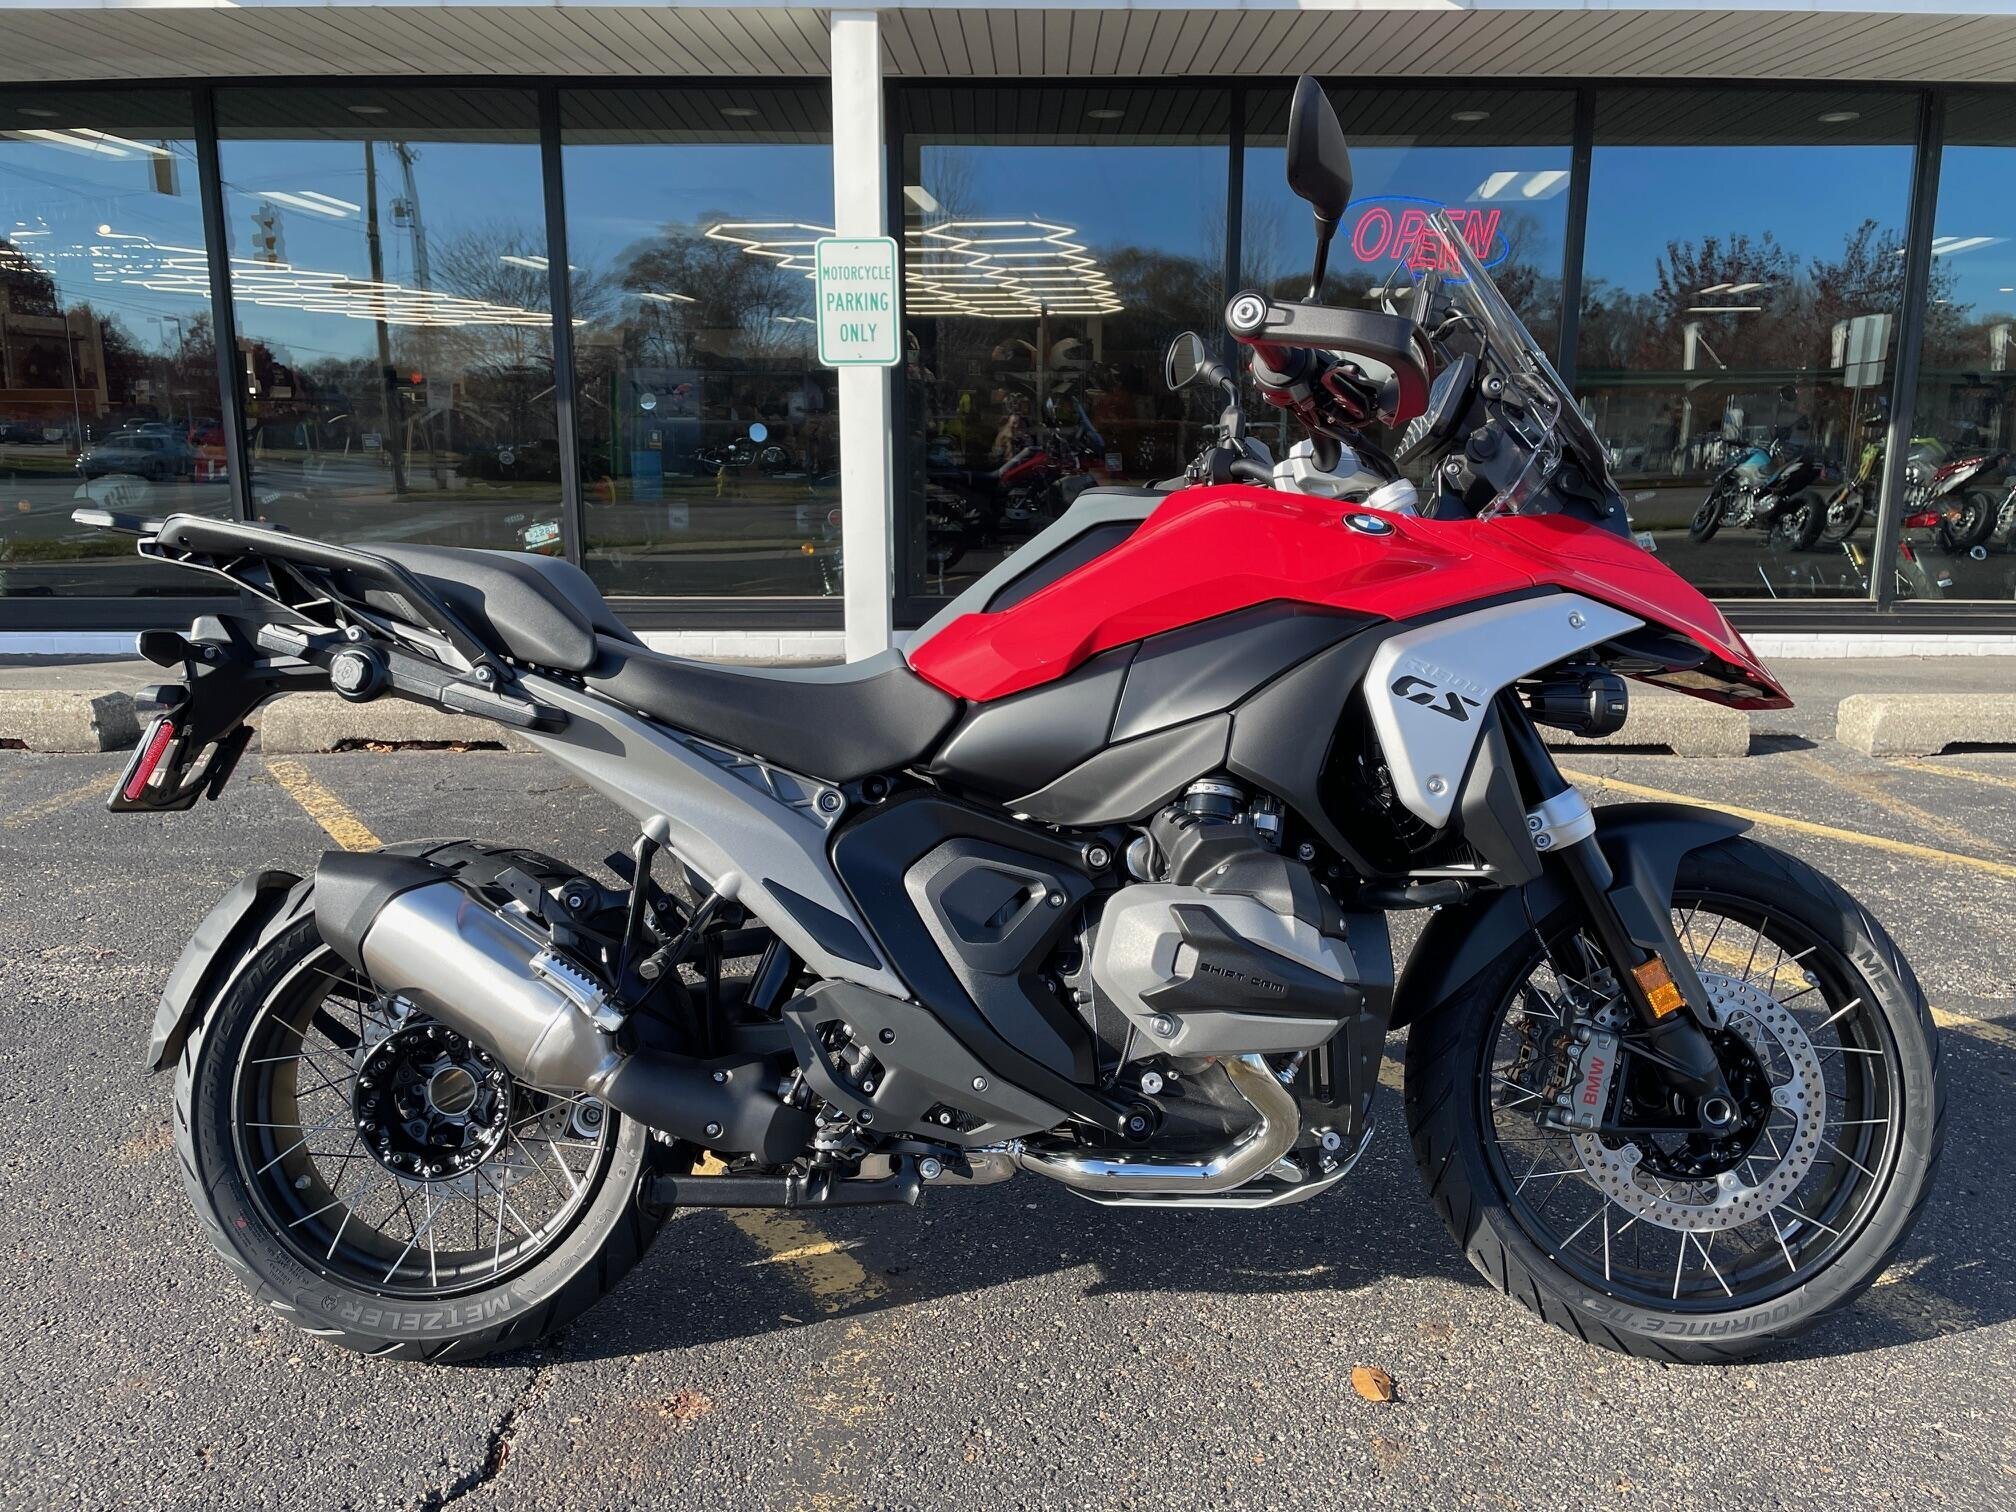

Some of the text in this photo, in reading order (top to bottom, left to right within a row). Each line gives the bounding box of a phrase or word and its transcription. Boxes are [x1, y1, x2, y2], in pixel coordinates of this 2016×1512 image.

[822, 266, 891, 280] MOTORCYCLE
[826, 292, 888, 312] PARKING
[840, 323, 877, 342] ONLY
[1391, 675, 1482, 722] GS
[249, 922, 311, 993] NEXT
[1200, 962, 1286, 993] SHIFT CAM
[1583, 1056, 1605, 1105] BMW
[340, 1293, 511, 1331] METZELER
[1640, 1296, 1808, 1336] TOURANCE
